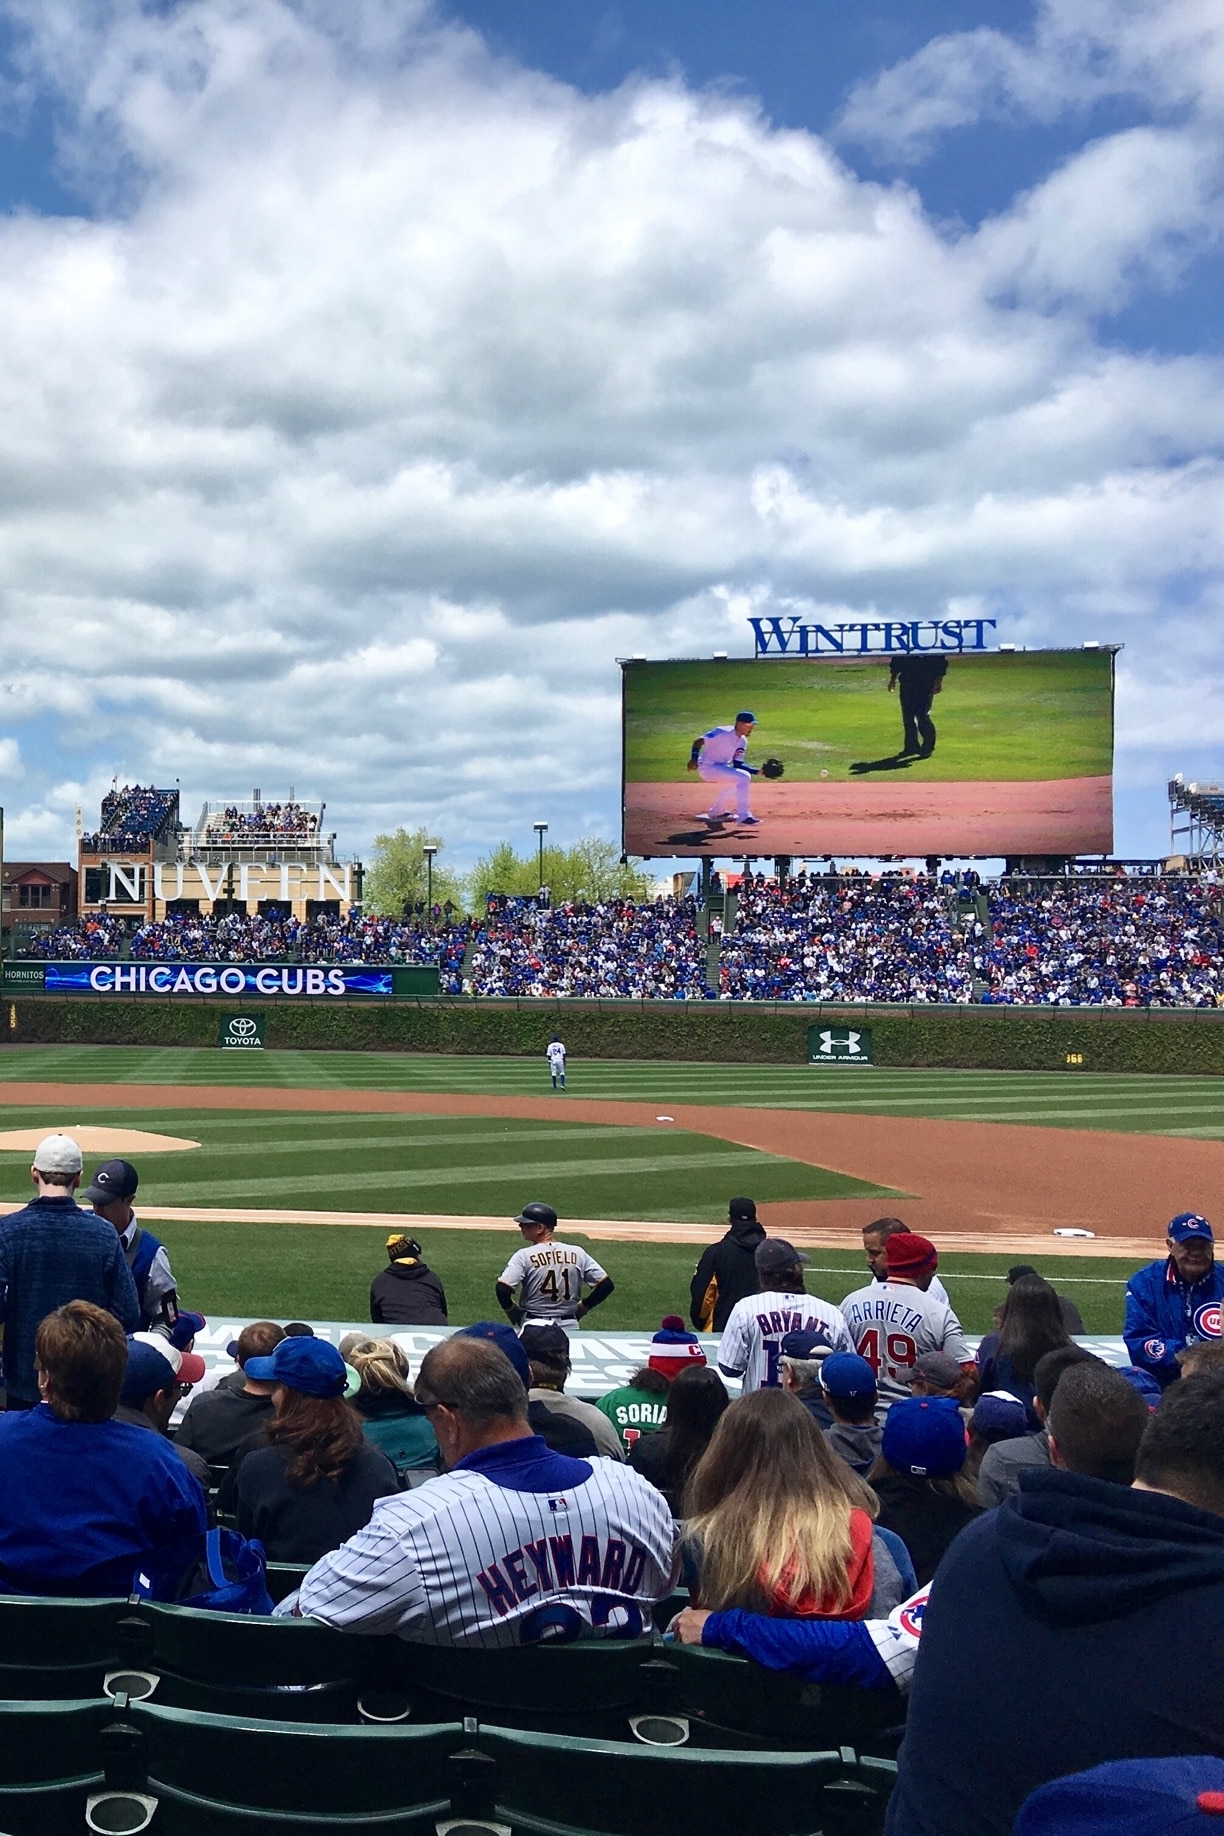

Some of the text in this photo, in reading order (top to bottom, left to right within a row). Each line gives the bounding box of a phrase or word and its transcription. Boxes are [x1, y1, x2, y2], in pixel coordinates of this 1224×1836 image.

[747, 616, 996, 654] WINTRUST
[105, 861, 352, 901] NUVEEN
[4, 970, 45, 979] HORNITOS
[89, 966, 346, 996] CHICAGO CUBS
[224, 1036, 262, 1046] TOYOTA
[529, 1250, 578, 1269] SOFIELD
[539, 1267, 571, 1302] 41
[851, 1300, 924, 1333] ARRIETA
[616, 1403, 668, 1425] SORIA
[476, 1534, 646, 1618] HEYWARD
